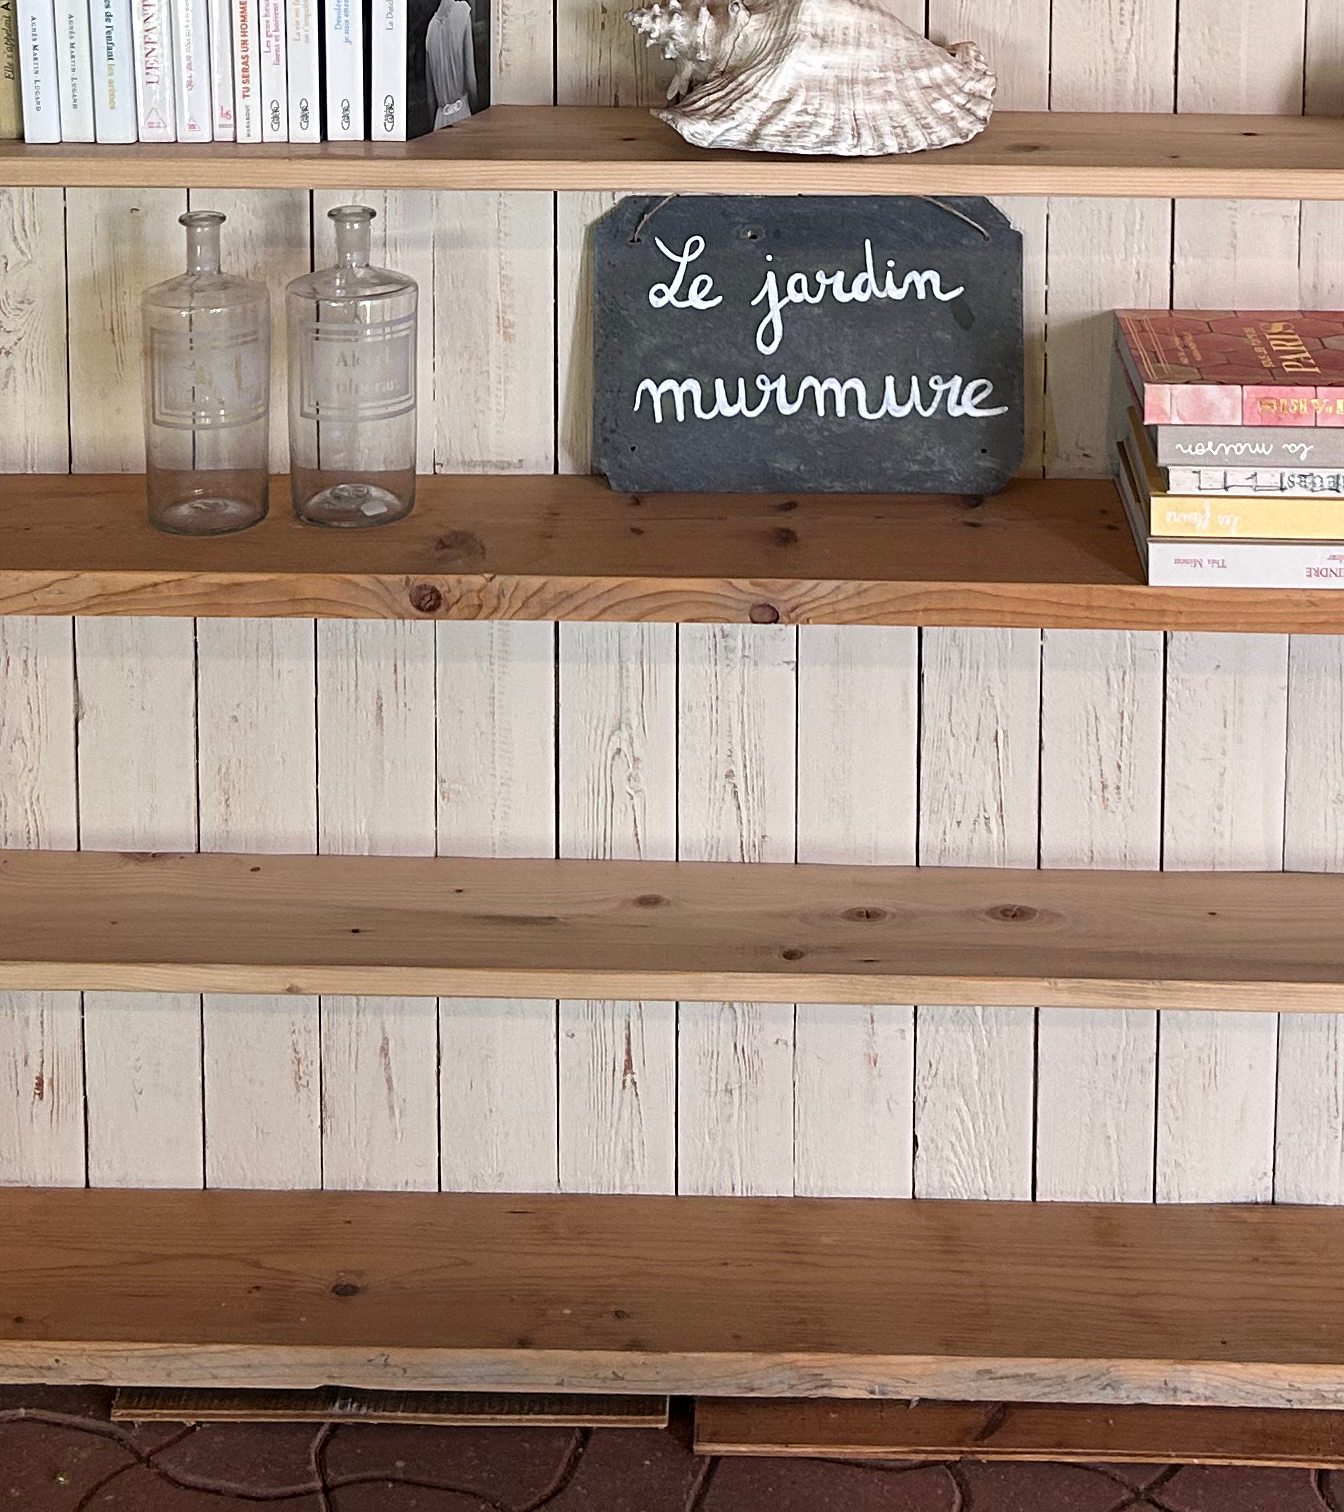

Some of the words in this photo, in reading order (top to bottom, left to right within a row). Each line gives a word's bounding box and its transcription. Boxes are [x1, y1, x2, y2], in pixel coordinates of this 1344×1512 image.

[103, 10, 114, 23] de
[238, 0, 249, 37] HOMME
[104, 25, 116, 61] l'enfant
[140, 0, 160, 85] L'ENFANT
[239, 38, 249, 52] UN
[106, 63, 116, 76] les
[240, 54, 251, 84] SERAS
[241, 86, 251, 98] TU
[646, 235, 724, 311] Le
[749, 238, 966, 356] jardin
[1257, 321, 1322, 373] PARIS
[632, 370, 1010, 425] murmure
[1175, 441, 1273, 459] maison
[1282, 443, 1313, 460] la
[1165, 502, 1212, 535] fleurs
[1218, 513, 1240, 533] les
